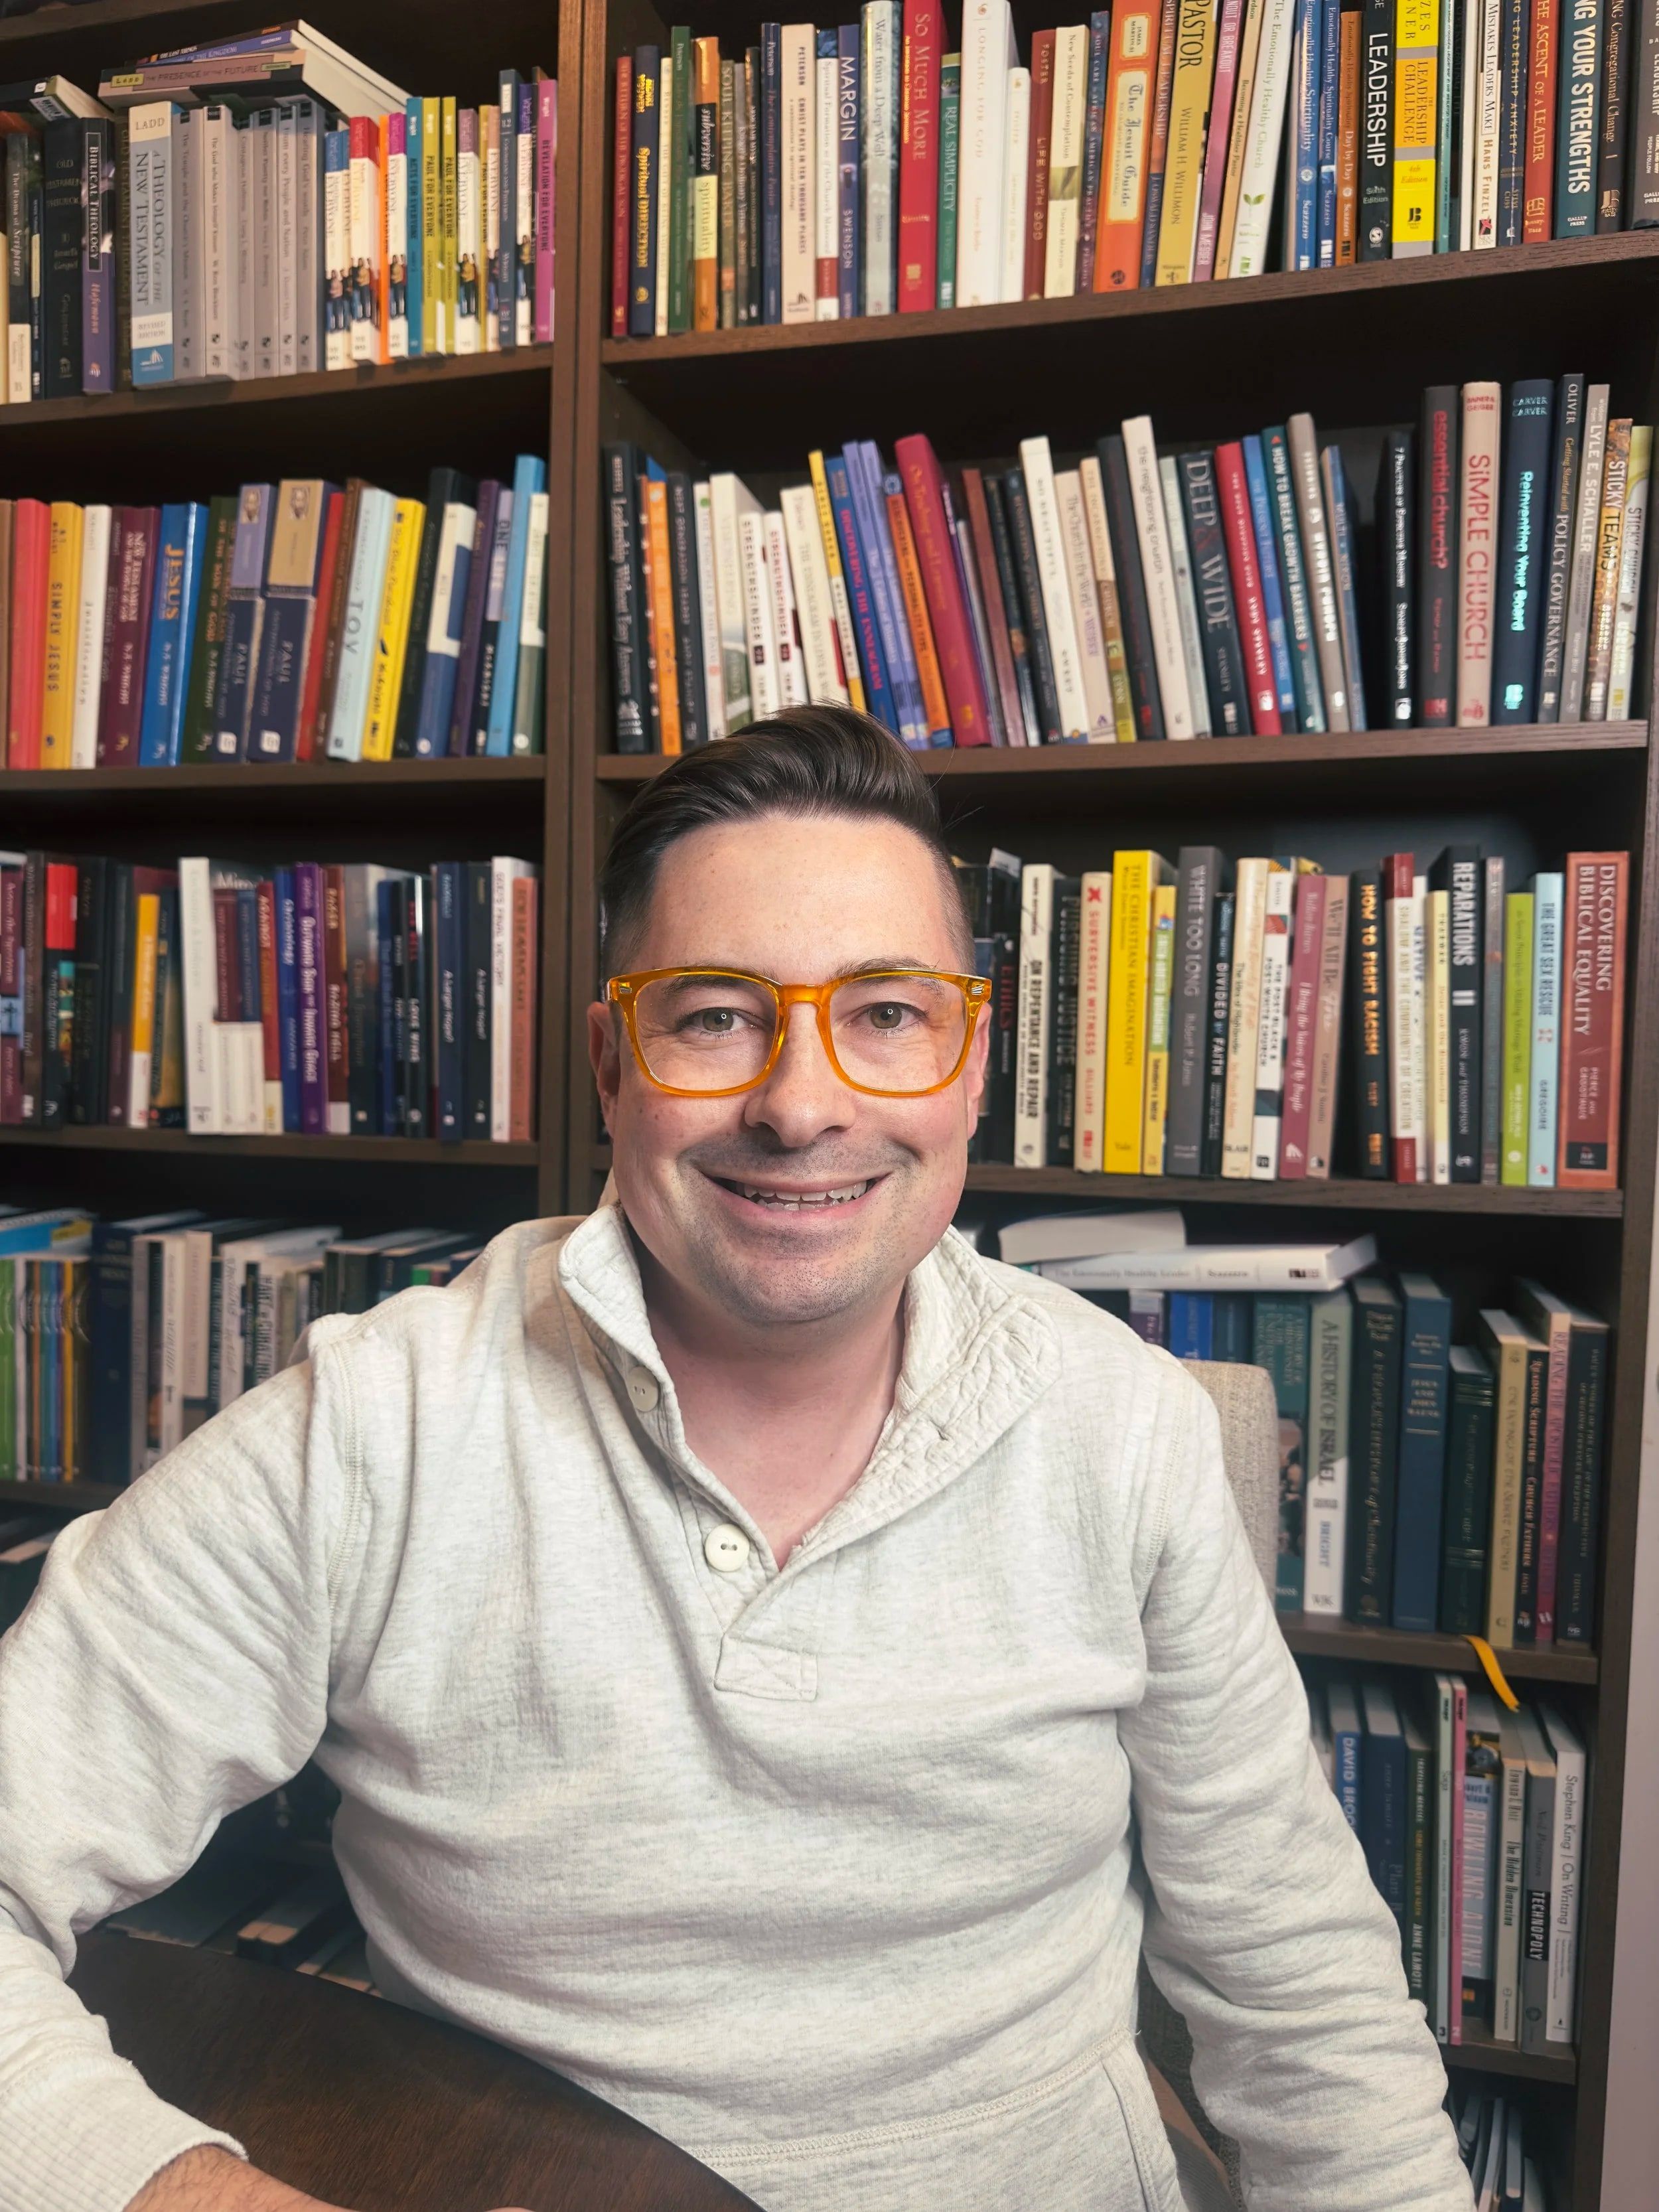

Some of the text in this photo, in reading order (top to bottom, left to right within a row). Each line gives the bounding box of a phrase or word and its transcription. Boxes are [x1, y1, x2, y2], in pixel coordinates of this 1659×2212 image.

[875, 19, 887, 58] Water
[1219, 35, 1235, 74] BREAKOUT
[1263, 23, 1283, 84] Emotionally
[1327, 7, 1337, 52] Emotionally
[1510, 20, 1521, 98] LEADERSHIP
[1535, 23, 1549, 78] ASCENT
[1571, 24, 1597, 78] YOUR
[840, 57, 856, 141] MARGIN
[875, 60, 883, 84] from
[912, 13, 931, 161] SO MUCH MORE
[1067, 54, 1076, 79] Seeds
[1128, 84, 1143, 111] The
[1484, 3, 1499, 131] MISTAKES LEADERS MAKE
[1534, 80, 1545, 95] OF
[1602, 22, 1623, 143] Congregational Change
[135, 117, 165, 131] LADD
[874, 95, 885, 123] Deep
[1062, 93, 1074, 160] Contemplation
[1177, 107, 1192, 151] WILLIAM
[1258, 85, 1274, 121] Healthy
[1300, 88, 1315, 152] Spirituality
[1366, 33, 1388, 167] LEADERSHIP
[1403, 64, 1416, 143] CHALLENGE
[1415, 62, 1429, 144] LEADERSHIP
[1509, 103, 1518, 155] ANXIETY
[426, 155, 435, 179] PAUL
[701, 108, 715, 171] subversive
[1254, 123, 1269, 169] Church
[1342, 131, 1355, 181] Day Day
[1532, 109, 1546, 163] LEADER
[1567, 82, 1594, 194] STRENGTHS
[88, 146, 100, 260] BIBLICAL THEOLOGY
[152, 160, 166, 258] THEOLOGY
[1171, 169, 1186, 226] WILLIMON
[1481, 139, 1493, 215] HANS FINZEL
[136, 152, 148, 304] NEW TESTAMENT
[697, 180, 714, 259] spirituality
[843, 209, 853, 269] SWENSON
[1565, 382, 1579, 425] OLIVER
[1431, 409, 1448, 495] essential
[1588, 425, 1602, 458] LYLE
[1187, 459, 1218, 527] DEEP
[1579, 479, 1597, 552] SCHALLER
[1605, 461, 1625, 508] STICKY
[163, 544, 184, 621] JESUS
[1200, 552, 1231, 633] WIDE
[1464, 551, 1488, 662] CHURCH
[1544, 514, 1569, 678] POLICY GOVERNANCE
[48, 581, 62, 692] SIMPLY JESUS
[344, 599, 364, 655] TOV
[232, 642, 248, 686] PAUL
[277, 640, 294, 684] PAUL
[1185, 917, 1204, 950] TOO
[1452, 861, 1476, 966] REPARATIONS
[1595, 865, 1617, 991] DISCOVERING
[1184, 954, 1201, 997] LONG
[1360, 884, 1380, 1055] HOW TO FIGHT RACISM
[1573, 865, 1597, 1035] BIBLICAL EQUALITY
[1084, 911, 1101, 1057] SUBVERSIVE WITNESS
[1210, 962, 1230, 1076] DIVIDED FAITH
[1559, 1775, 1579, 1926] Stephen King On Writing
[1529, 1891, 1546, 1961] TECHNOPOLY
